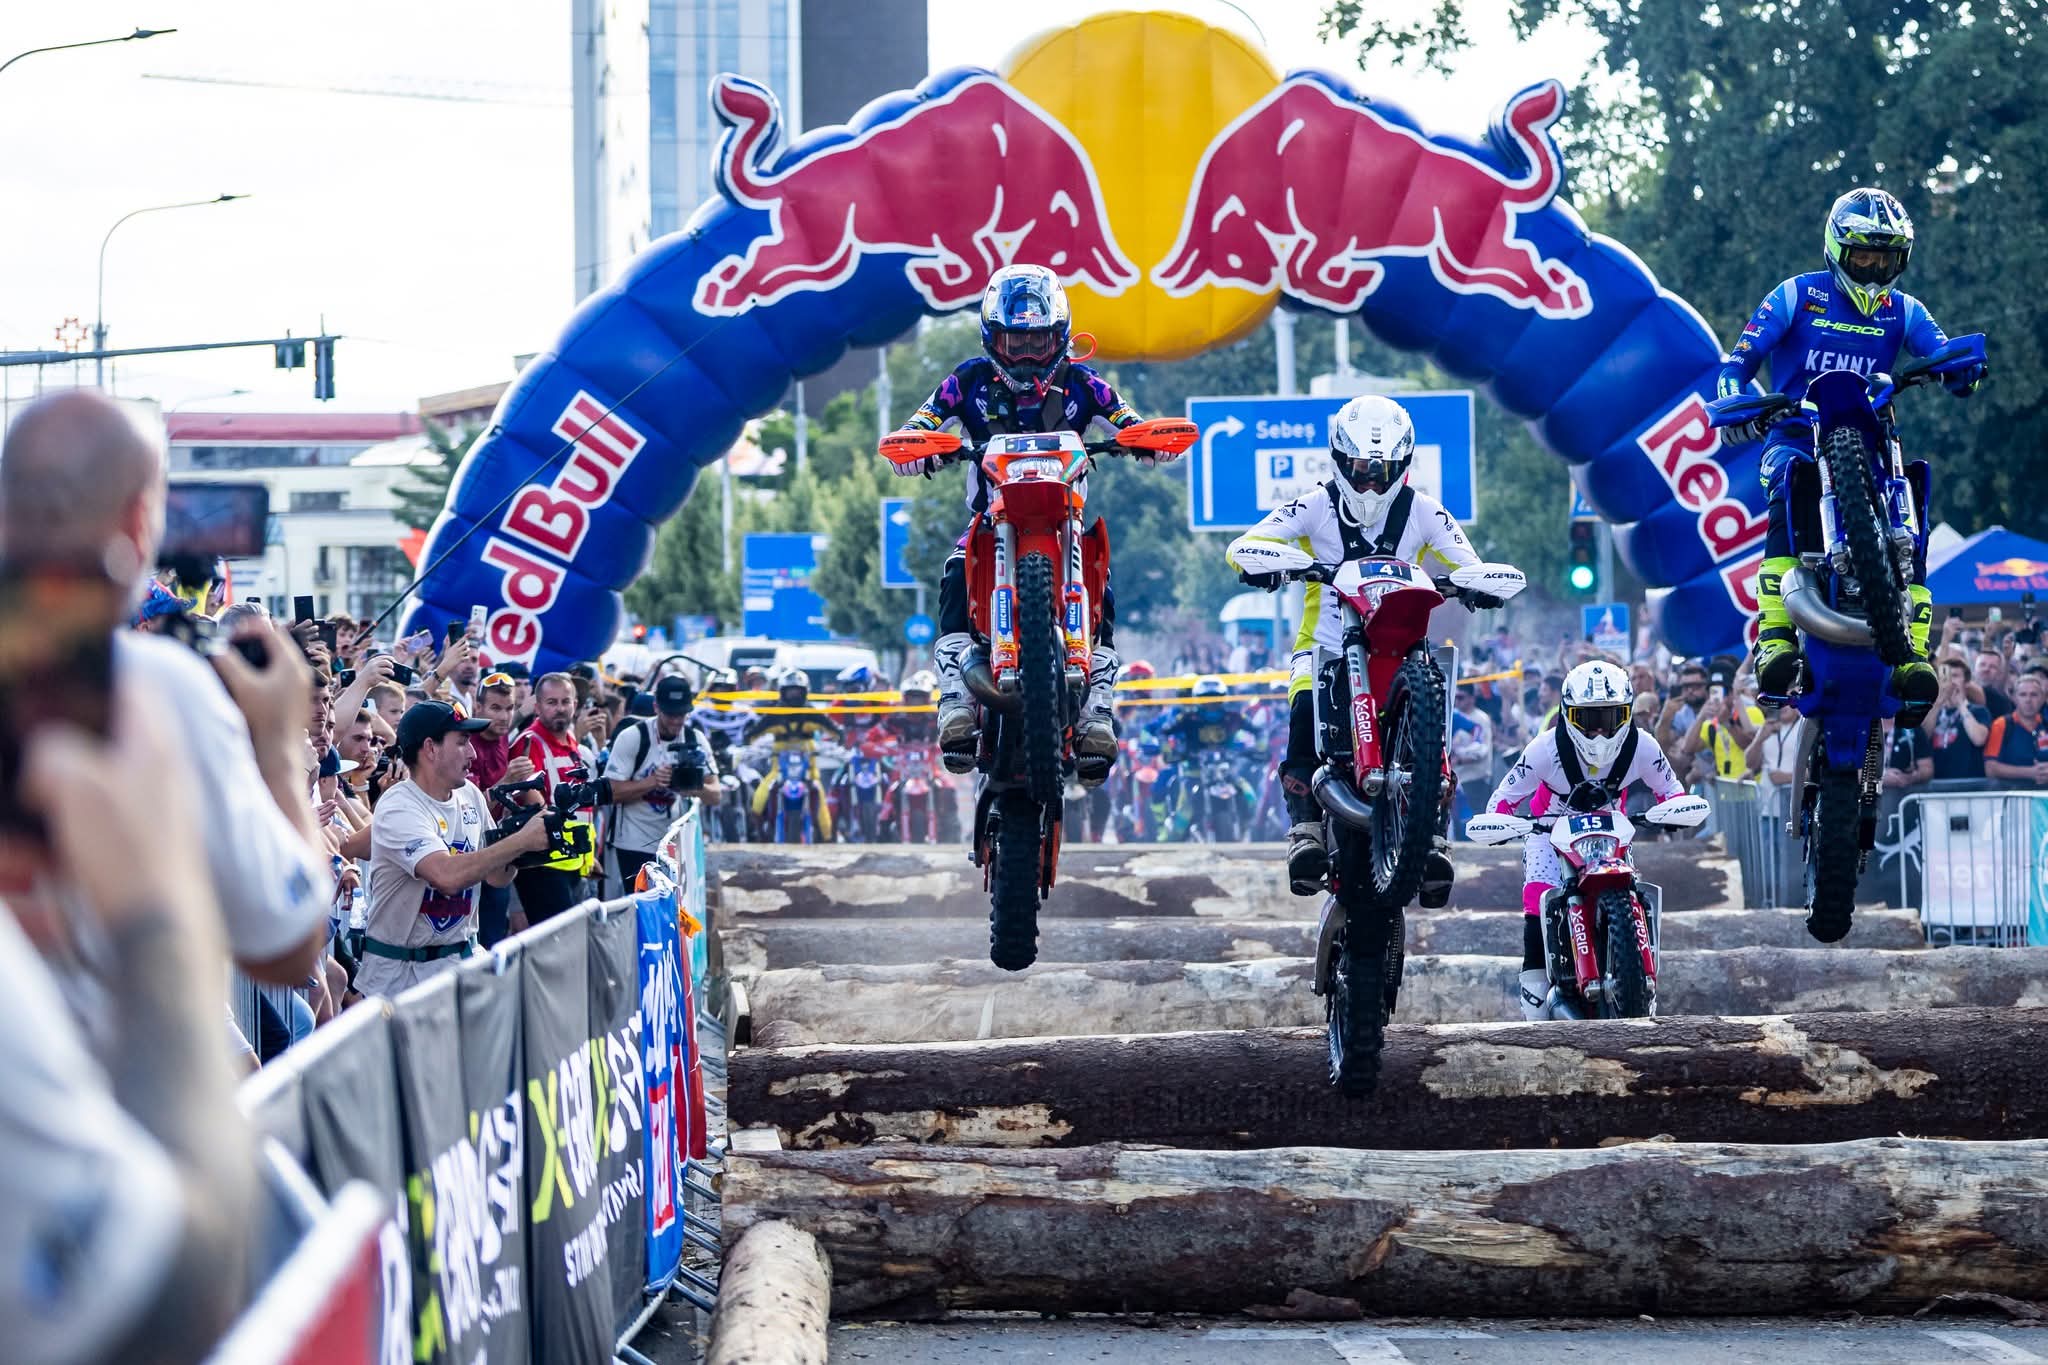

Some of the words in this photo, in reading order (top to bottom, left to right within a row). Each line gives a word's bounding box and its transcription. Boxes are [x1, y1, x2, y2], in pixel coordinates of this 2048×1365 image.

[1811, 318, 1886, 337] SHERCO
[1804, 349, 1878, 375] KENNY
[1026, 439, 1039, 451] 1
[503, 394, 643, 559] Bull
[1641, 397, 1769, 560] Red
[1236, 547, 1281, 558] ACERBIS
[1379, 563, 1394, 575] 4
[1483, 572, 1524, 581] ACERBIS
[480, 540, 565, 669] ed
[999, 591, 1007, 628] MICHELIN
[1354, 697, 1373, 743] X-GRIP
[1672, 803, 1709, 815] ACERBIS
[1468, 824, 1506, 832] ACERBIS
[1580, 816, 1603, 830] 15
[1570, 909, 1590, 956] X-GRIP
